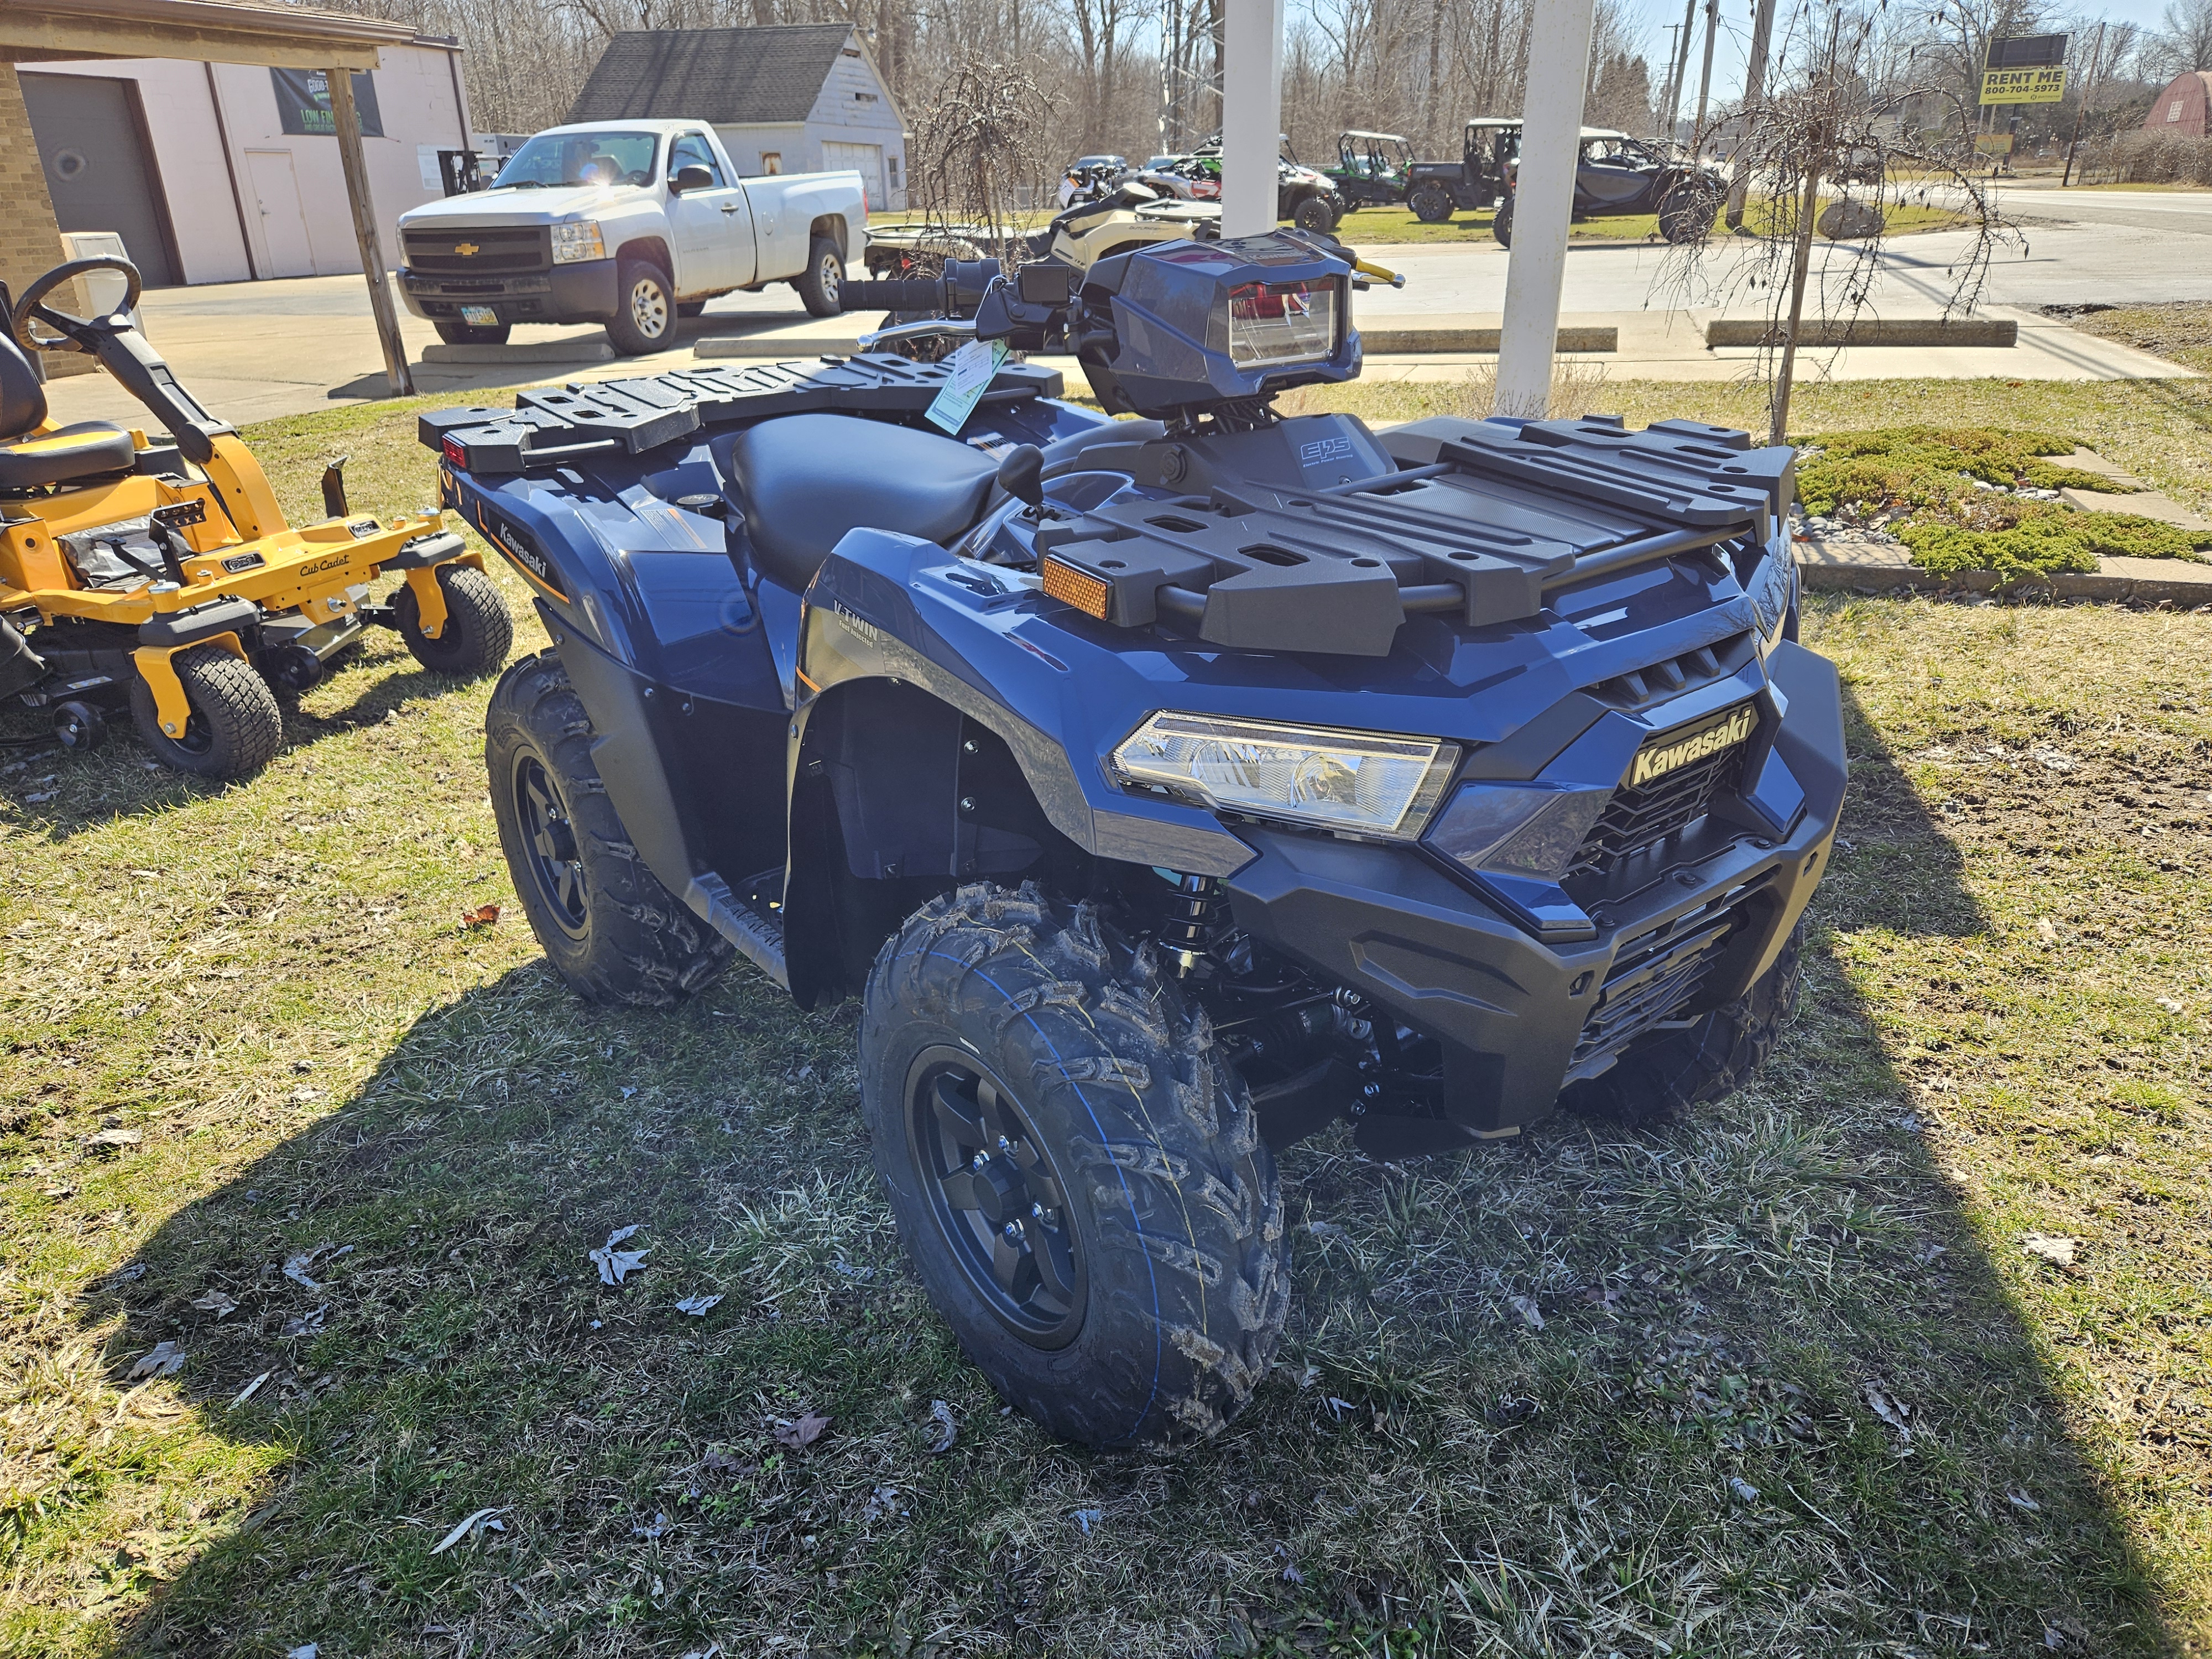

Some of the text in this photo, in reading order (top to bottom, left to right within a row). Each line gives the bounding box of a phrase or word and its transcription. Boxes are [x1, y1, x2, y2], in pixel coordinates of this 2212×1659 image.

[1986, 71, 2063, 85] RENT ME
[1985, 85, 2060, 94] 800-704-5973
[301, 109, 319, 123] LOW
[1249, 251, 1310, 260] Kawasaki
[1301, 437, 1350, 460] EPS
[500, 522, 546, 578] Kawasaki
[300, 555, 349, 577] Cub Cadet
[834, 599, 878, 641] V-TWIN
[839, 619, 873, 648] Fuel Injected
[1633, 709, 1751, 785] Kawasaki
